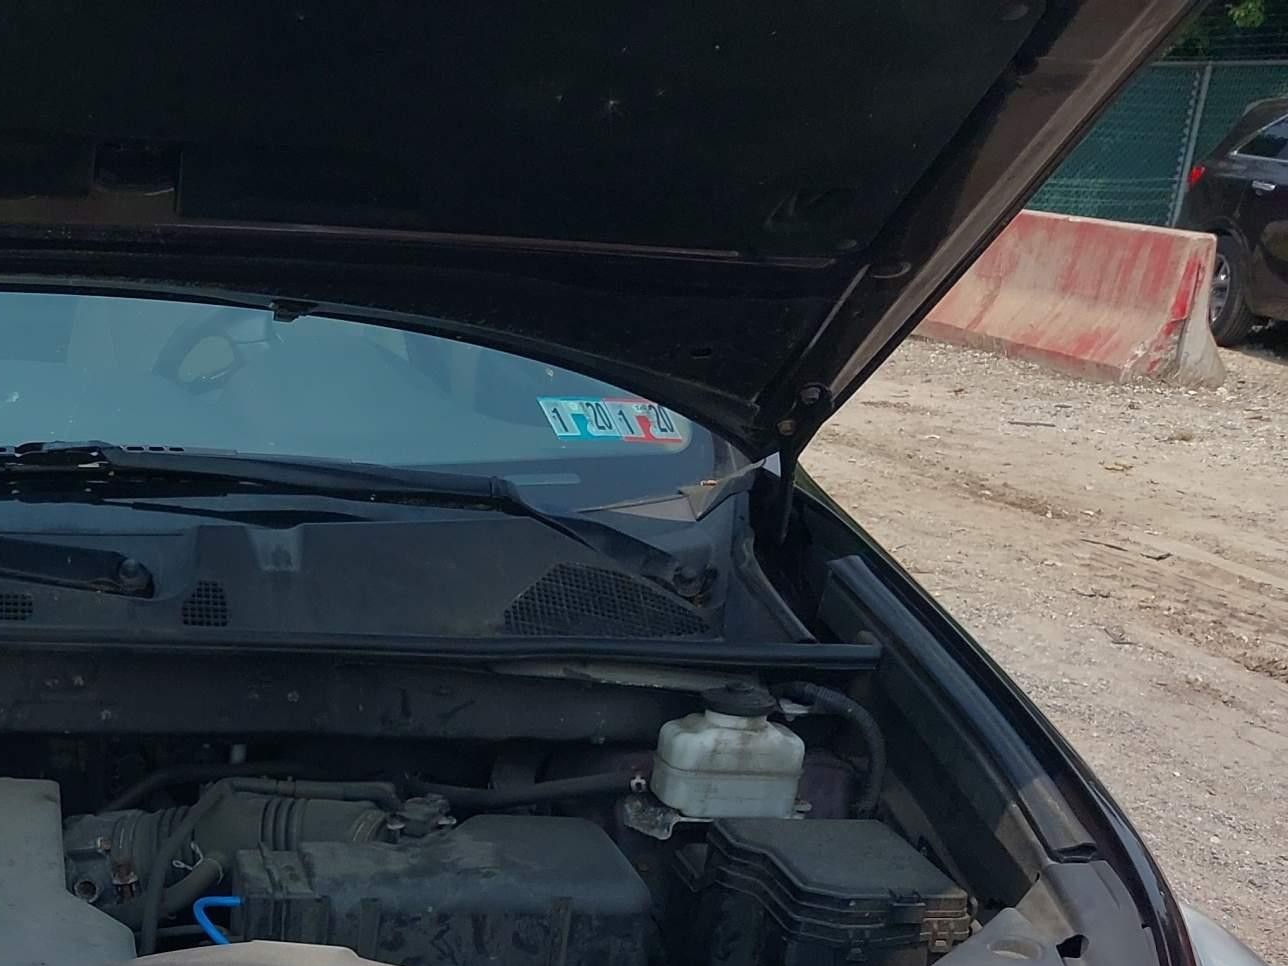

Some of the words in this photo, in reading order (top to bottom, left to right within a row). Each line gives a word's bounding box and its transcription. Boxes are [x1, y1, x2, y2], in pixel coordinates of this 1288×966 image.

[552, 407, 569, 432] 1
[585, 402, 613, 431] 20
[618, 409, 635, 434] 1
[648, 404, 675, 433] 20
